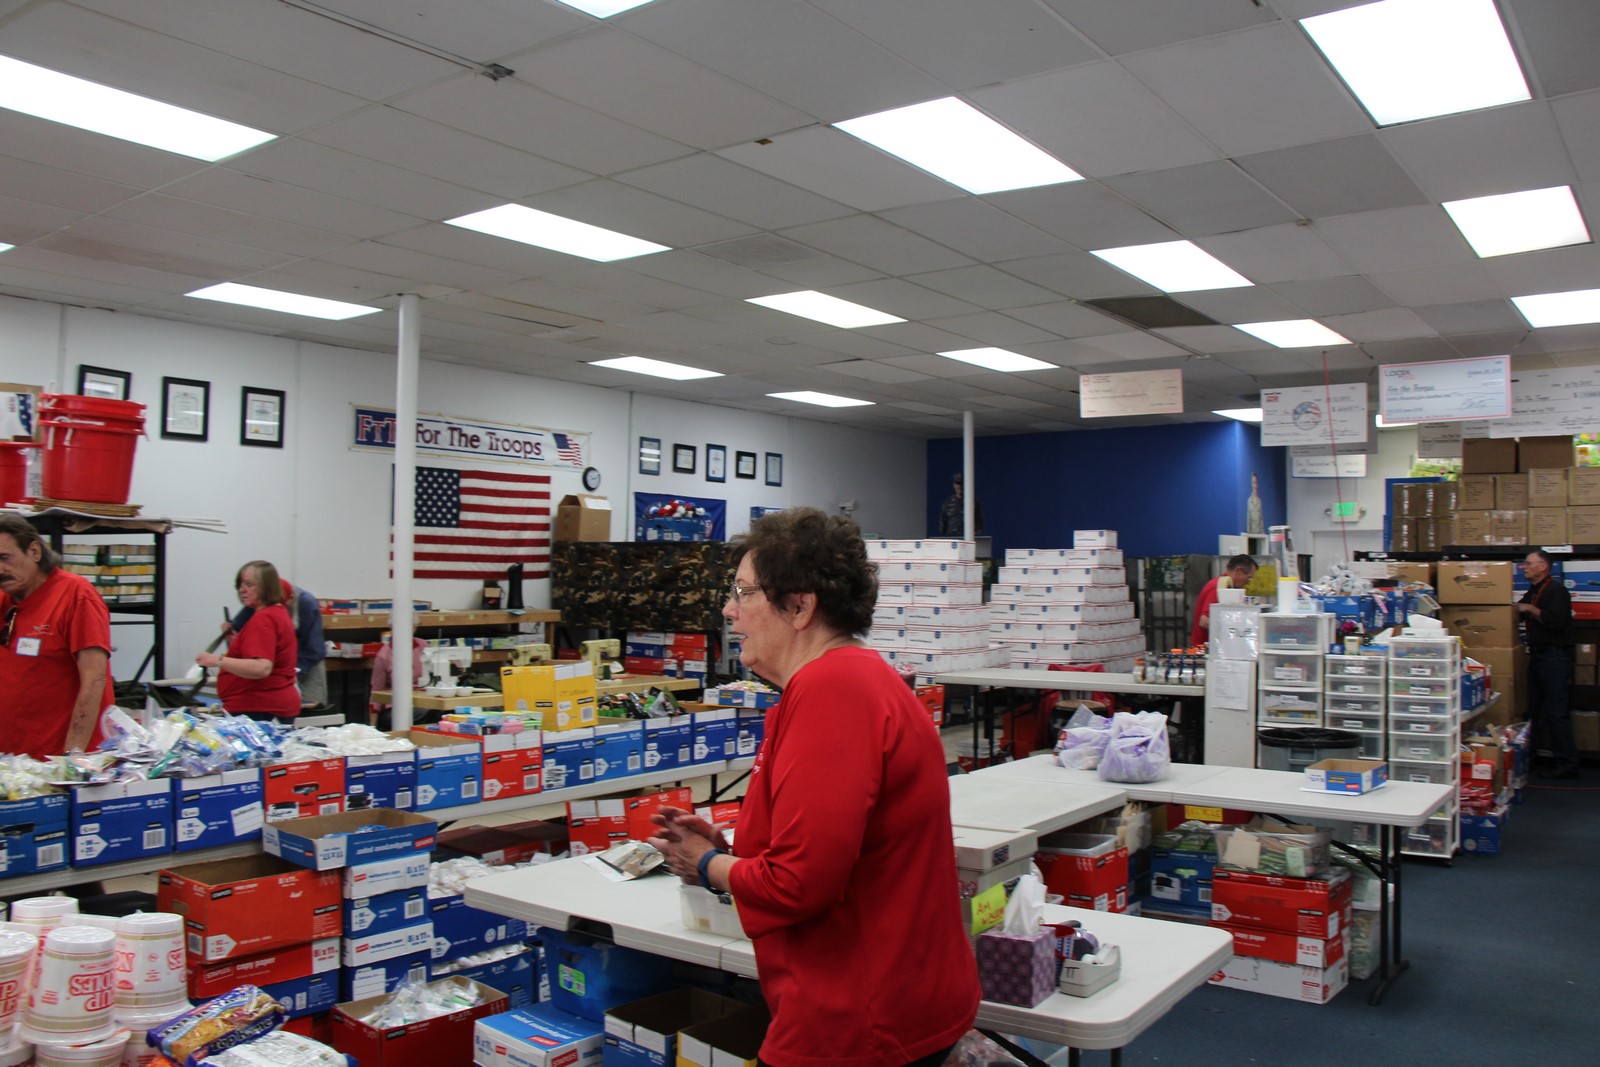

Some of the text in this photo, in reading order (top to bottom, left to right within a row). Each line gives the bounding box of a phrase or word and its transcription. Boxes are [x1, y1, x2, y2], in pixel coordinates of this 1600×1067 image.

[416, 422, 542, 459] For The Troops
